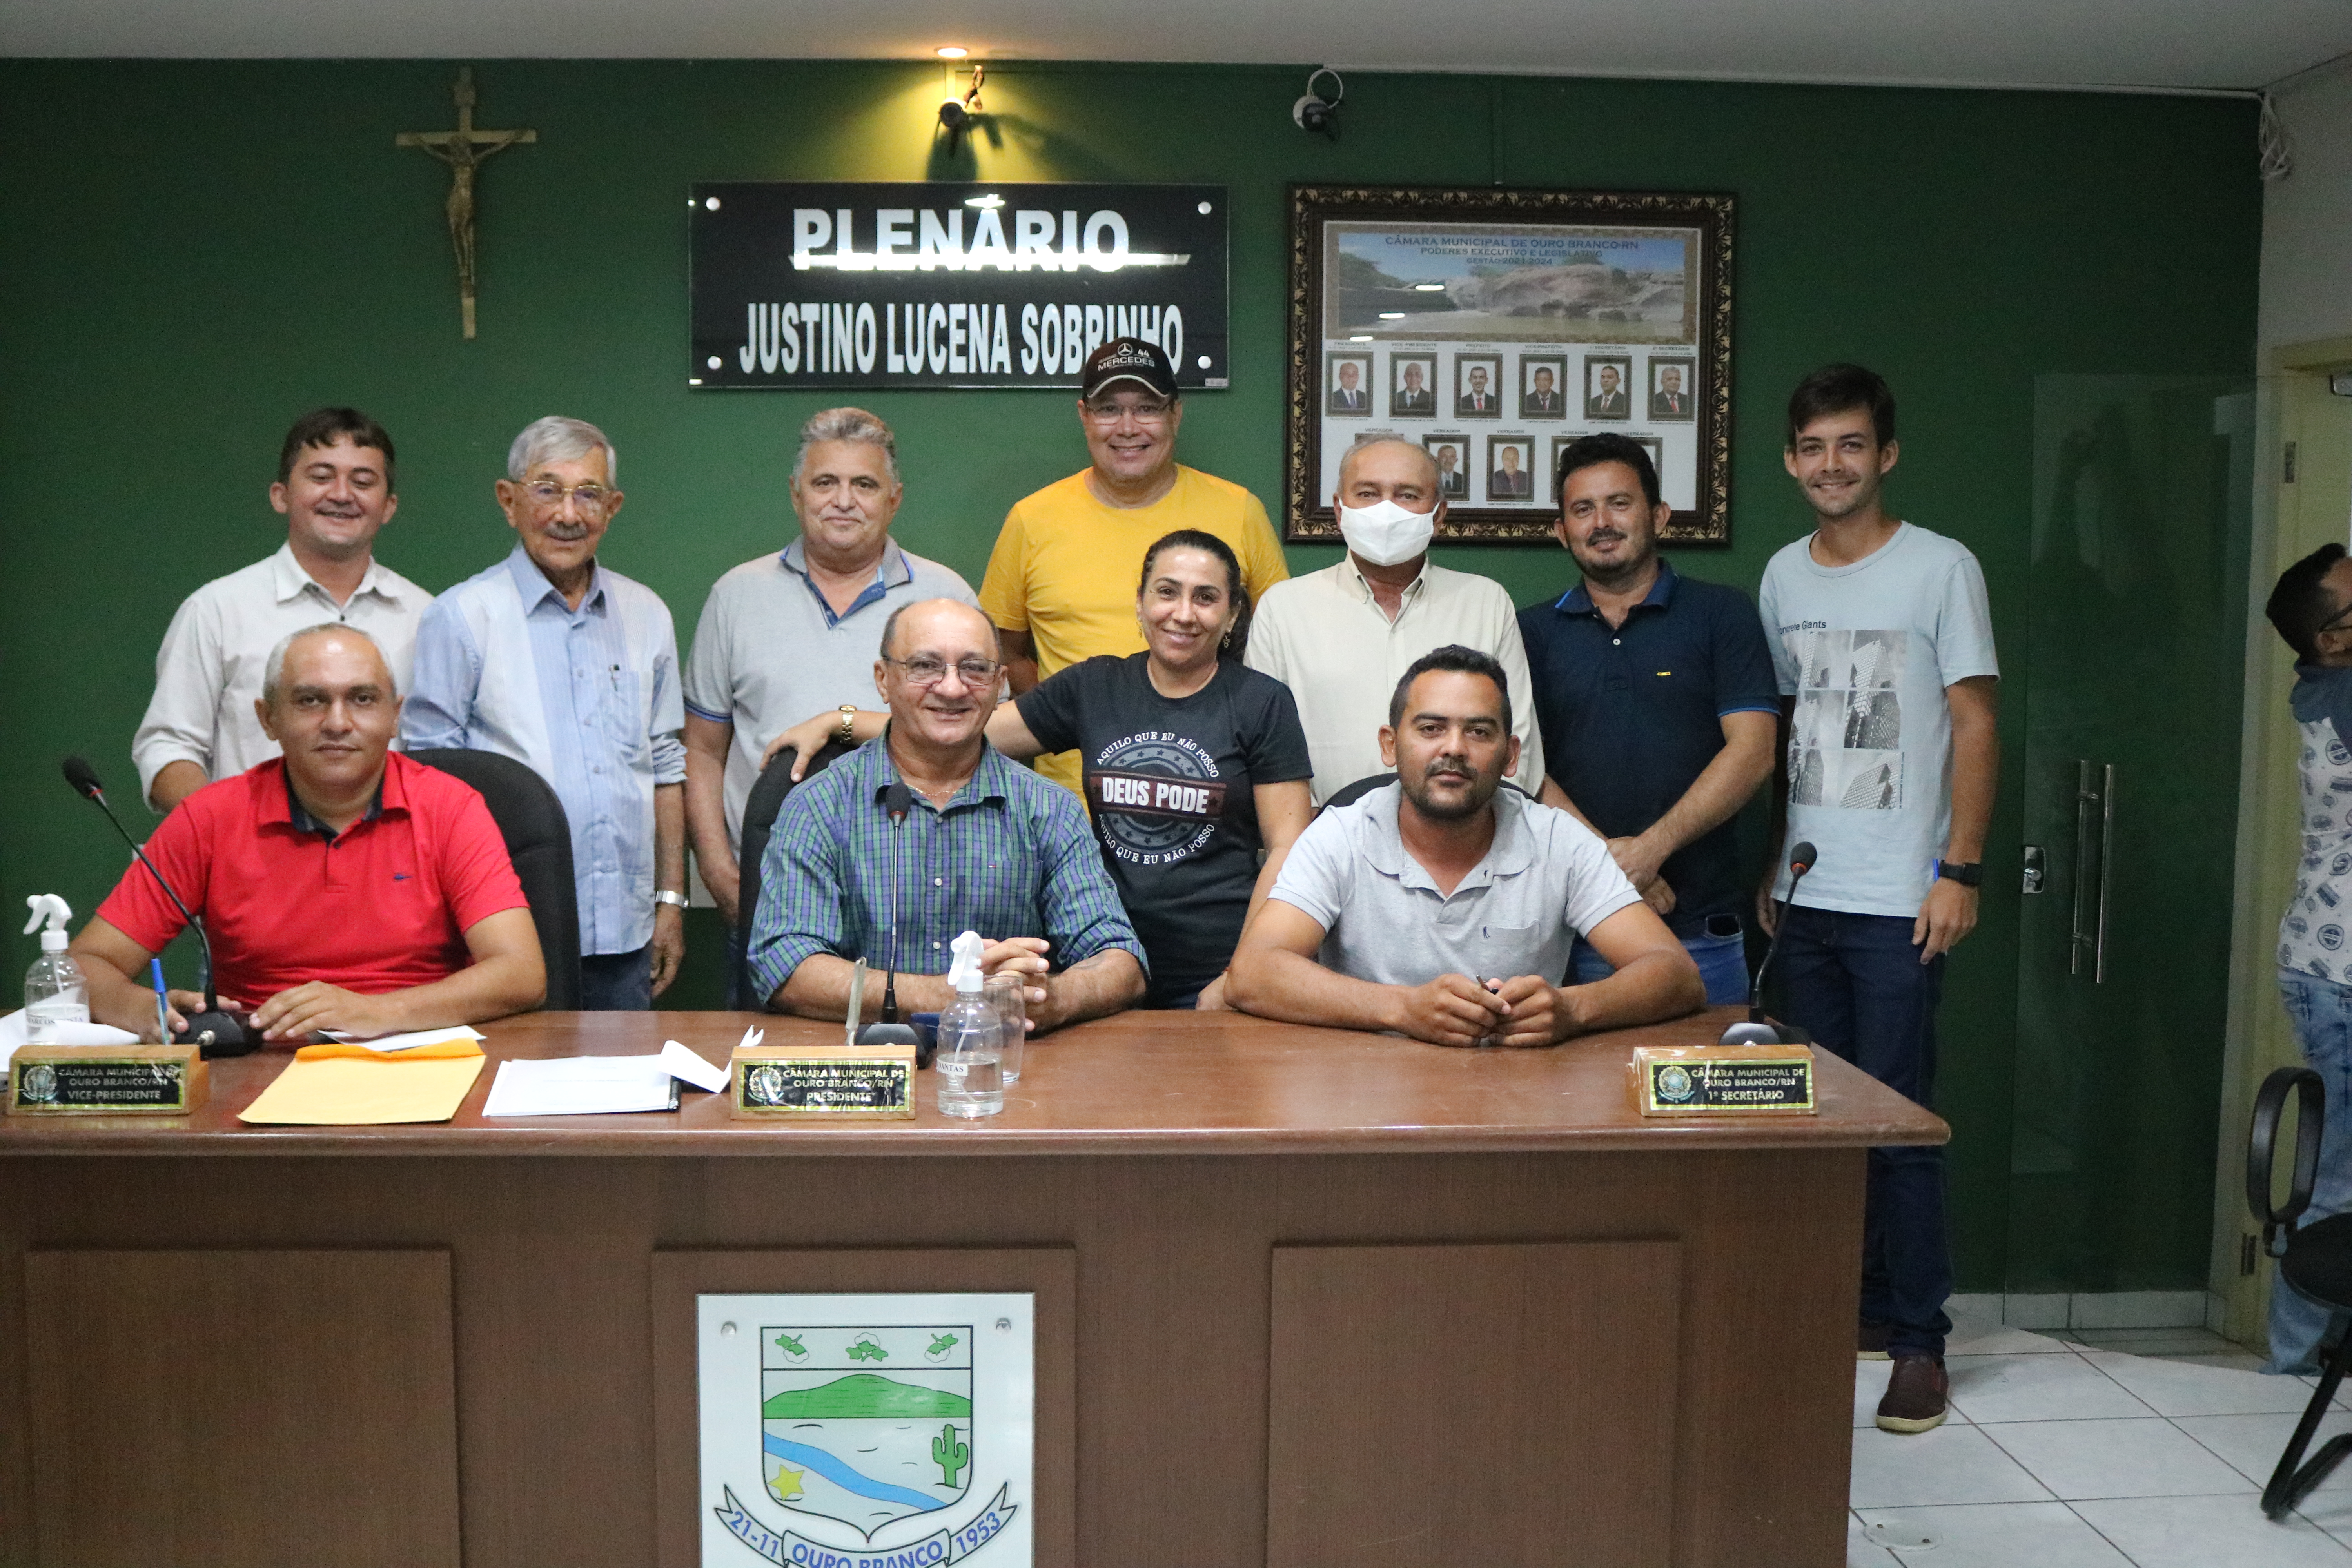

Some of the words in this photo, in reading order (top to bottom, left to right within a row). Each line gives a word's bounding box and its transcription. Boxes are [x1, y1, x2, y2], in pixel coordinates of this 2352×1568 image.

[1385, 235, 1438, 245] CÂMARA
[1441, 237, 1507, 247] MUNICIPAL
[1511, 239, 1527, 247] DE
[1531, 239, 1564, 248] OURO
[739, 302, 877, 374] JUSTINO
[887, 302, 1011, 374] LUCENA
[1098, 356, 1154, 371] MERCEDES
[1096, 737, 1131, 765] AQUILO
[1134, 731, 1158, 743] QUE
[1161, 732, 1175, 741] EU
[1176, 738, 1197, 751] NÃO
[1195, 748, 1220, 778] POSSO
[1102, 777, 1150, 807] DEUS
[1156, 782, 1209, 813] PODE
[1116, 846, 1140, 862] QUE
[1143, 855, 1158, 864] EU
[1163, 848, 1186, 862] NÃO
[1187, 824, 1215, 853] POSSO
[58, 1067, 103, 1076] CÂMARA
[783, 1067, 828, 1078] CÂMARA
[831, 1069, 888, 1078] MUNICIPAL
[1734, 1078, 1796, 1087] BRANCO/RN
[67, 1090, 161, 1100] VICE-PRESIDENTE
[806, 1092, 872, 1102] PRESIDENTE
[1708, 1091, 1719, 1100] 1º
[1721, 1088, 1784, 1100] SECRETÁRIO
[730, 1511, 780, 1558] 21-11
[792, 1543, 852, 1568] OURO
[955, 1511, 1000, 1555] 1953
